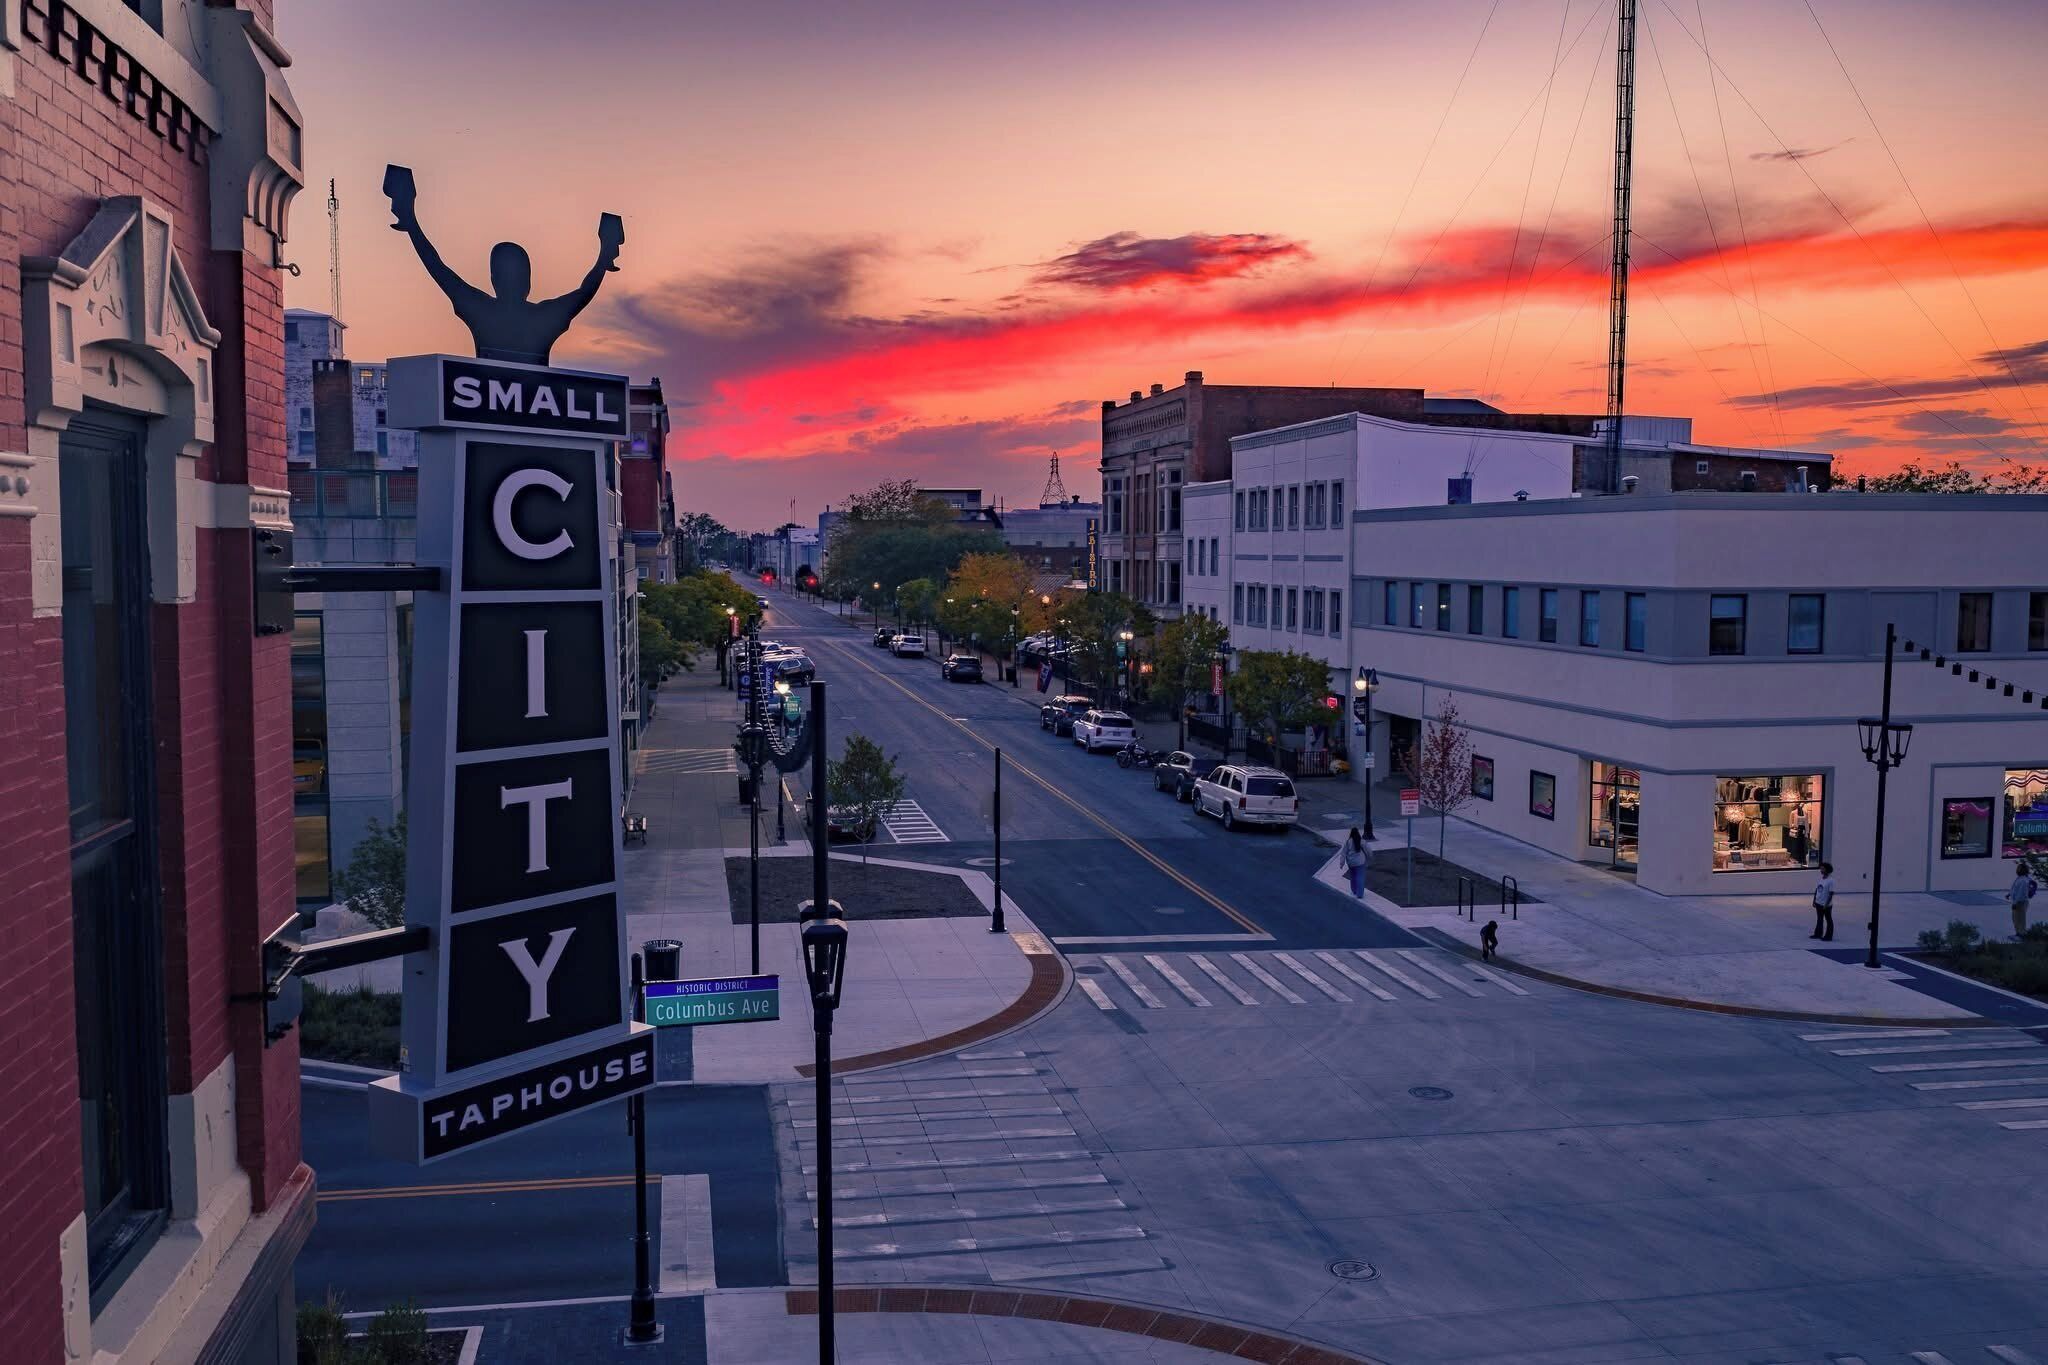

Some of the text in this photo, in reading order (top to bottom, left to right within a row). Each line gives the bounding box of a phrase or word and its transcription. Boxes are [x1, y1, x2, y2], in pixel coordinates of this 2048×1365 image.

[452, 376, 620, 423] SMALL
[492, 467, 577, 1023] CITY
[655, 999, 770, 1021] Columbus Ave
[676, 980, 749, 994] HISTORIC DISTRICT
[431, 1050, 648, 1137] TAPHOUSE
